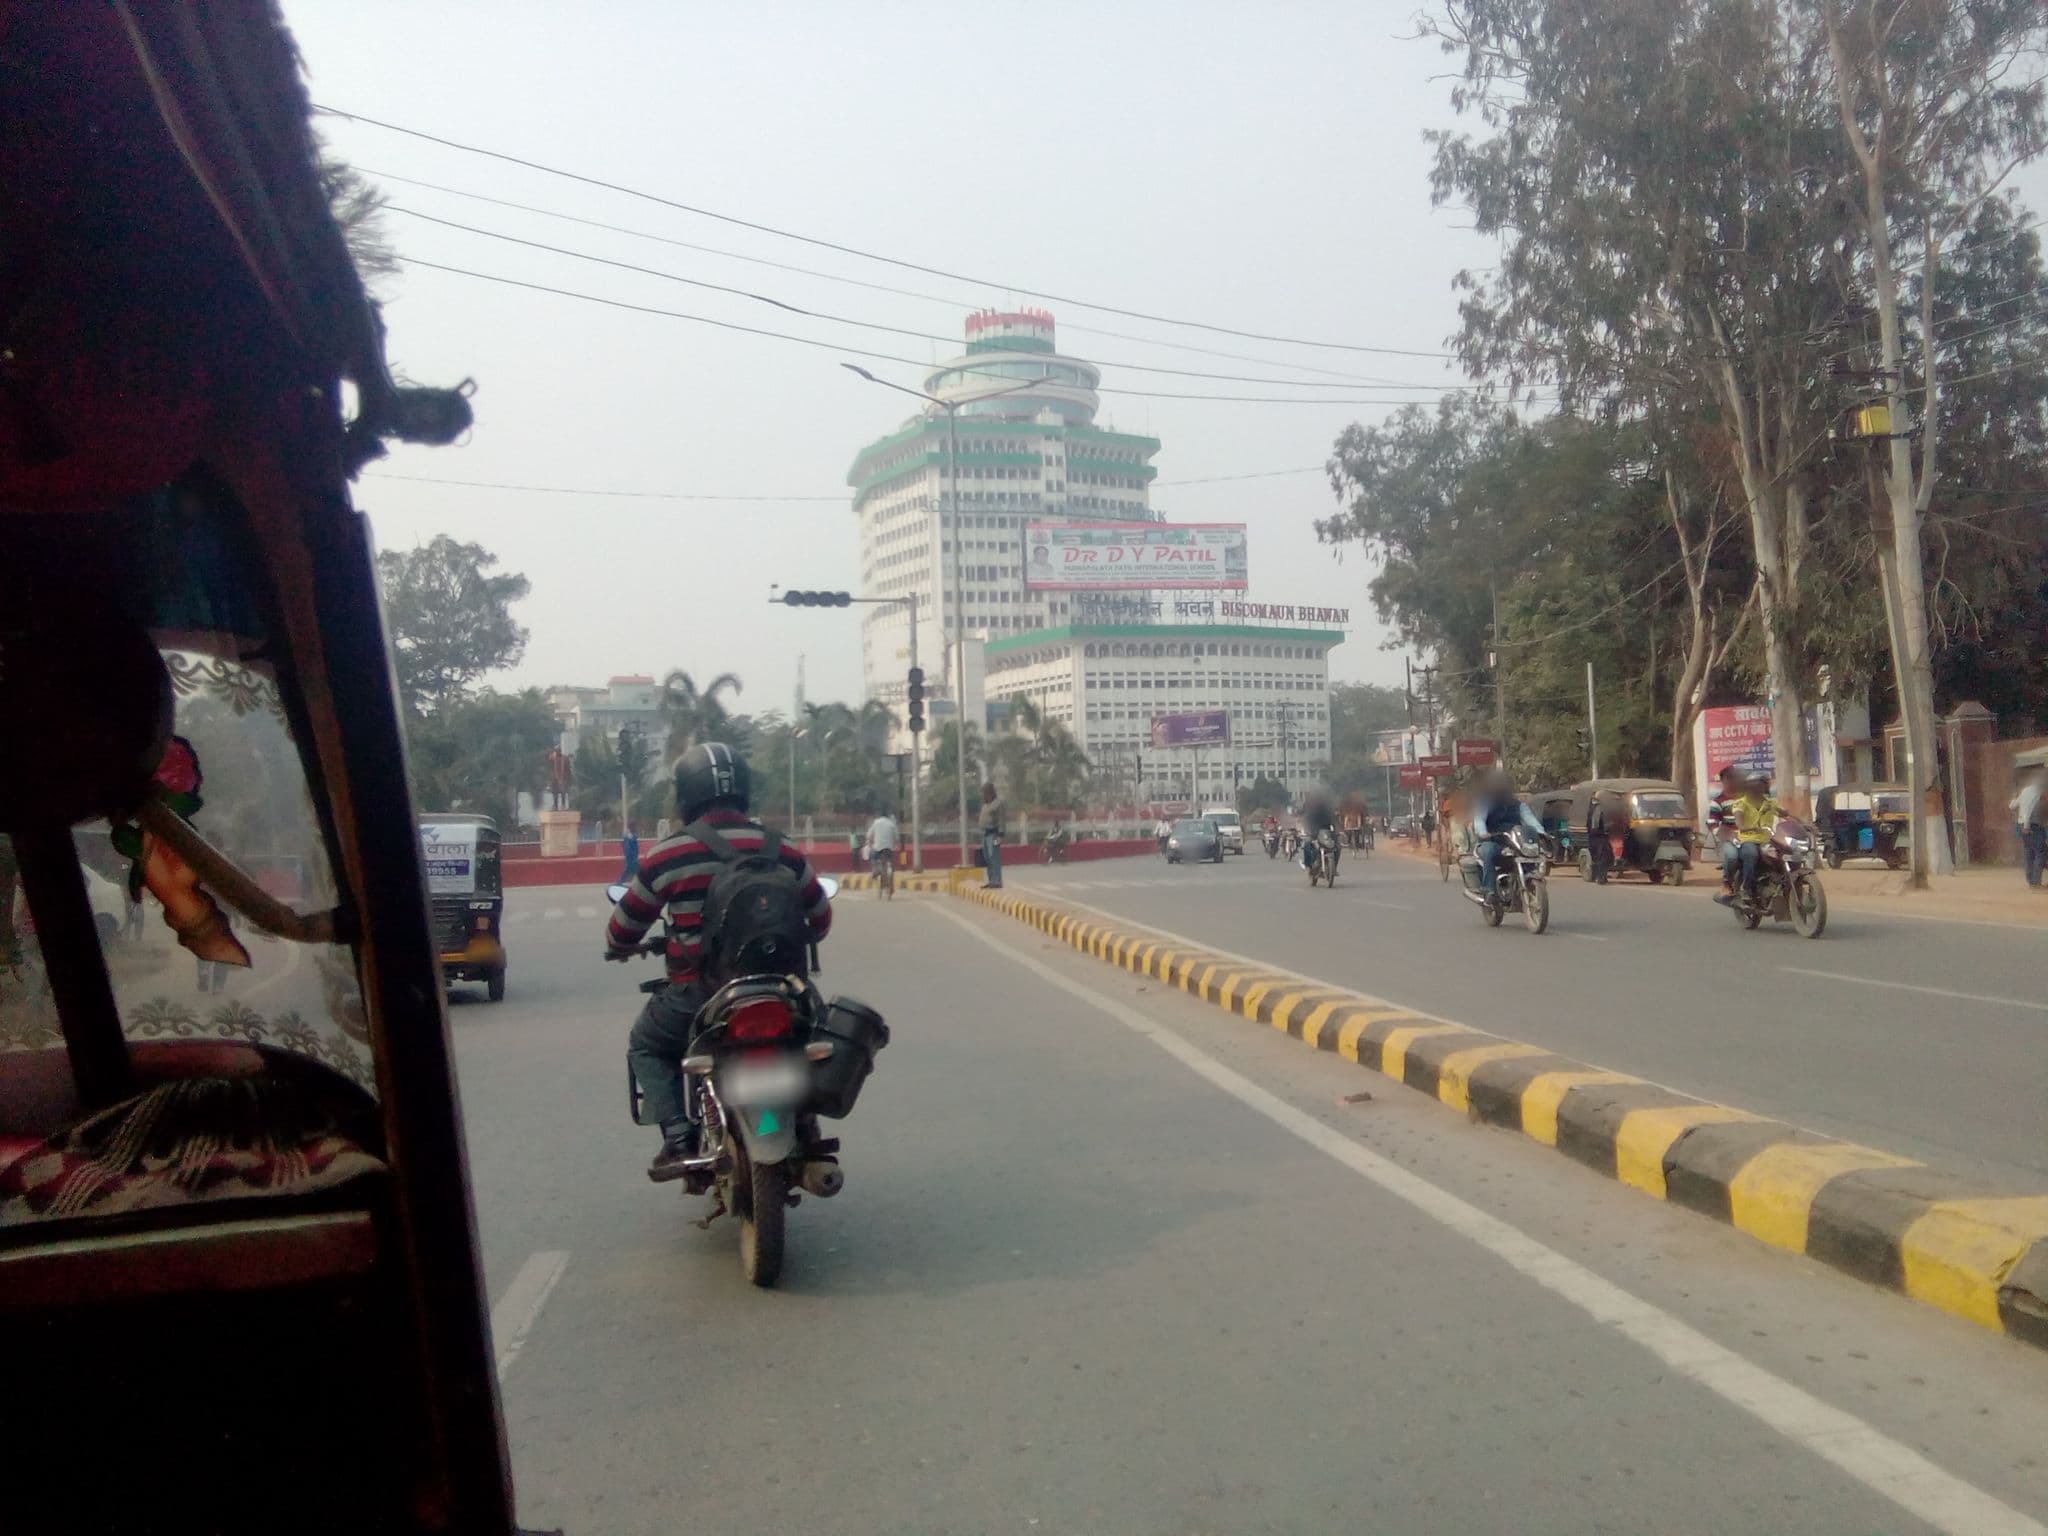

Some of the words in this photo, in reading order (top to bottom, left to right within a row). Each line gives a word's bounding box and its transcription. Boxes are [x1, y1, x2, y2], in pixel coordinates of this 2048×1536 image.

[1106, 547, 1124, 563] D
[1132, 547, 1145, 562] Y
[1221, 600, 1295, 620] BISCOMAUN
[1298, 606, 1350, 623] BHAWAN
[1724, 724, 1749, 738] CCTV
